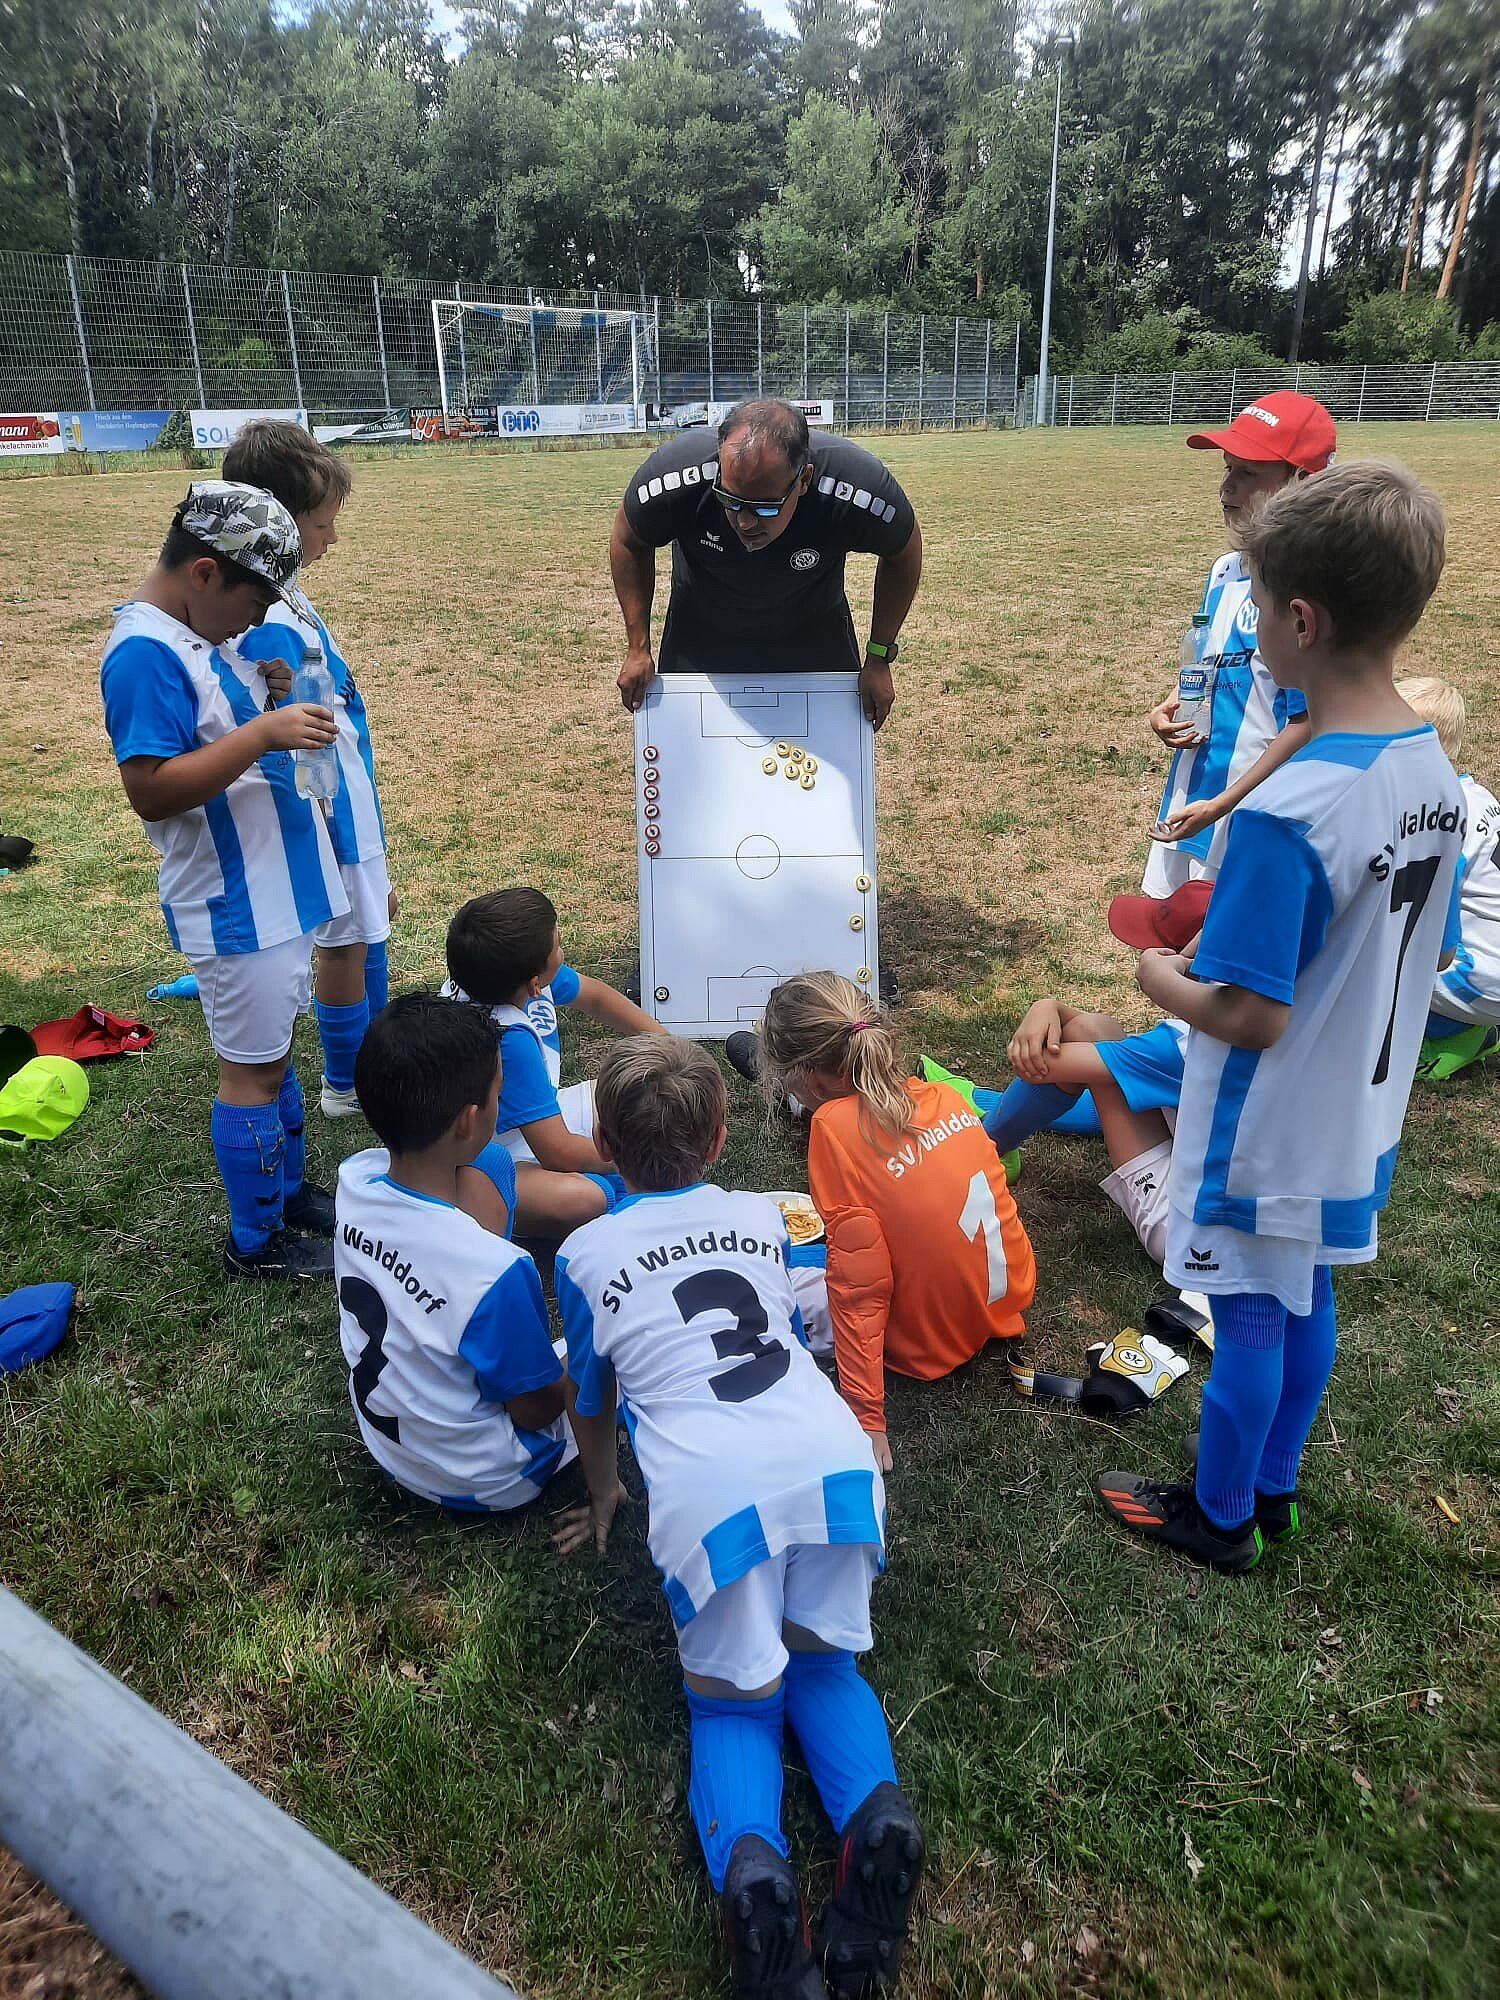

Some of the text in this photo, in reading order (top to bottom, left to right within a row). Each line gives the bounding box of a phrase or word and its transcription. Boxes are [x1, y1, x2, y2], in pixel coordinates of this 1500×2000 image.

[1371, 856, 1442, 1085] 7
[886, 1143, 917, 1179] SV
[343, 1223, 448, 1314] Walddorf
[602, 1268, 634, 1314] SV
[958, 1169, 1008, 1306] 1
[1184, 1262, 1220, 1271] erima
[340, 1276, 402, 1446] 2
[671, 1268, 791, 1404] 3
